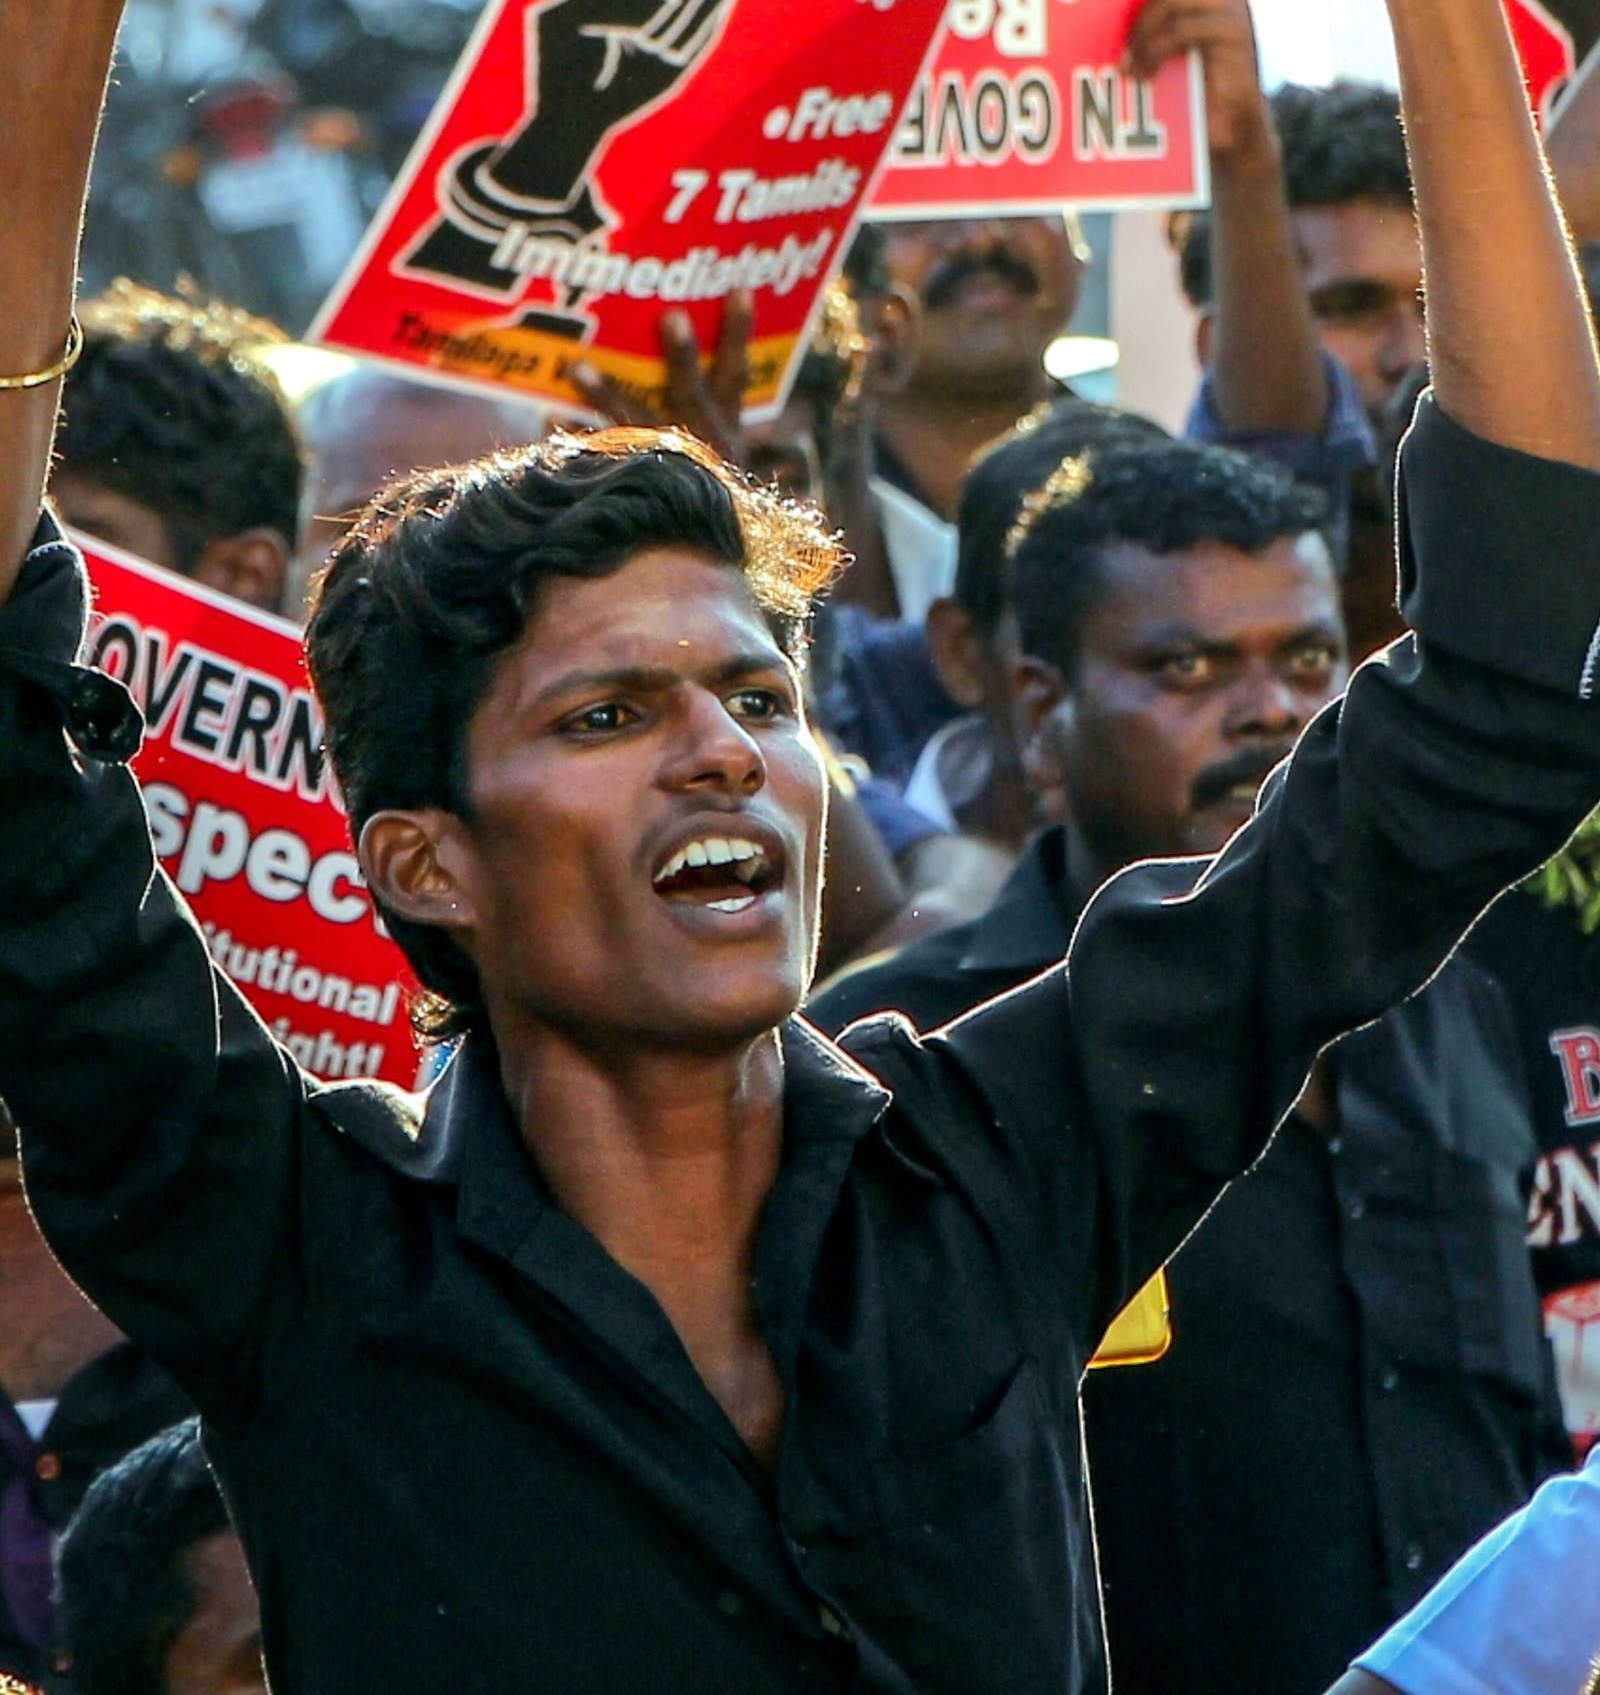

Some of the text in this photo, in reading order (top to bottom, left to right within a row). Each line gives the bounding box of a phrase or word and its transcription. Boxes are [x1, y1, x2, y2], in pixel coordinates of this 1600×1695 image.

[788, 87, 893, 142] Free
[663, 158, 862, 224] 7 Tamils
[490, 222, 834, 301] Immediately!
